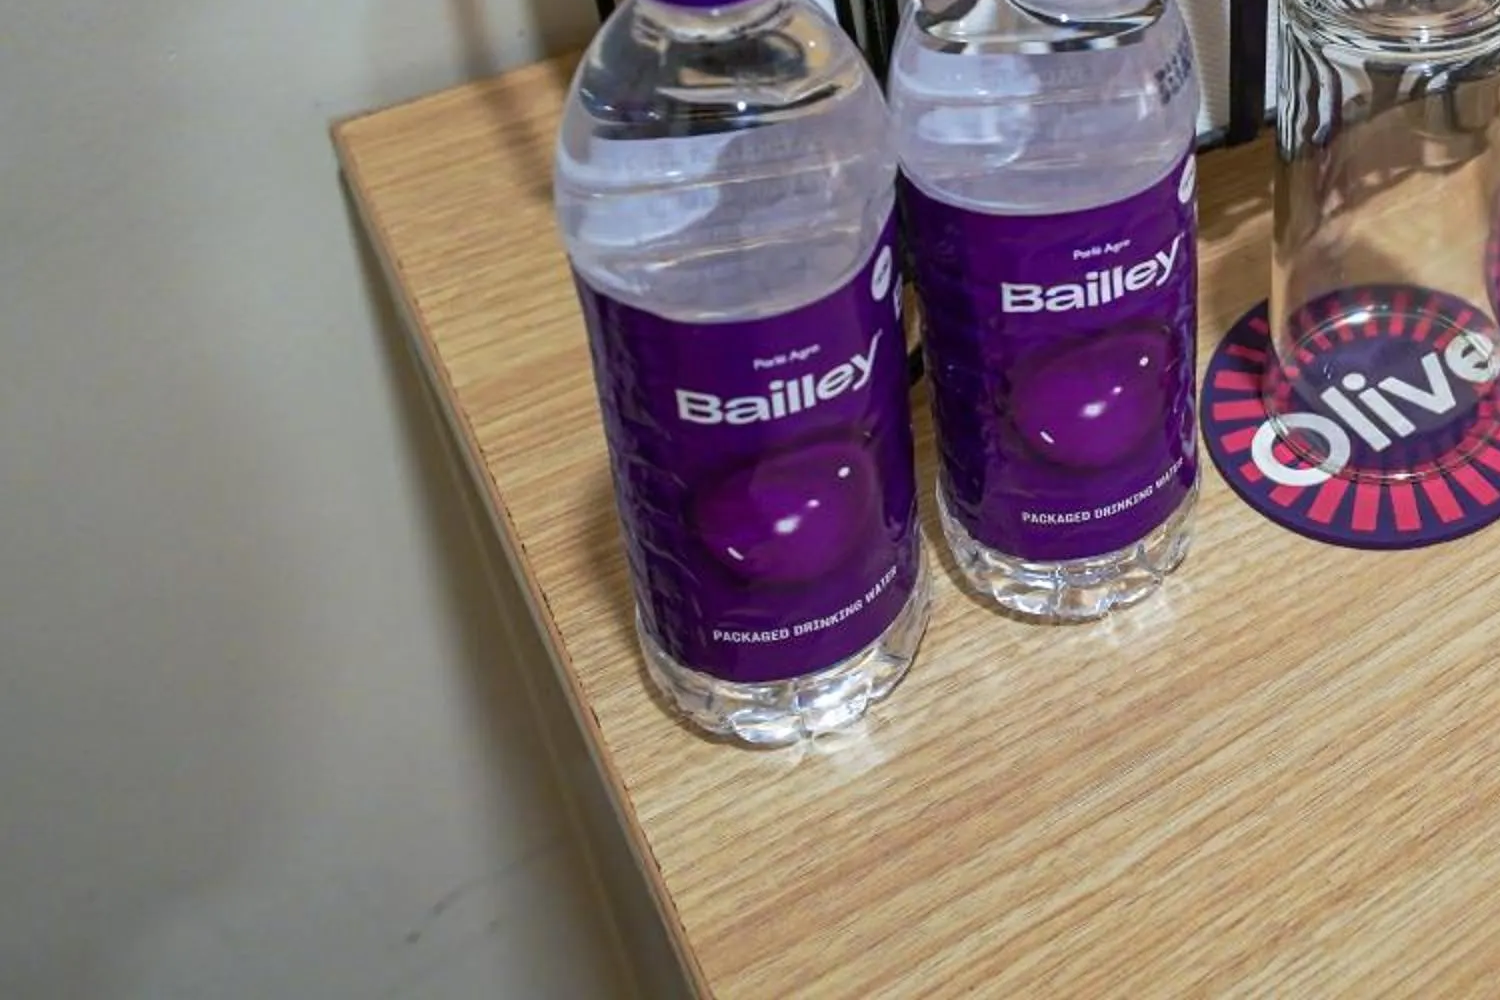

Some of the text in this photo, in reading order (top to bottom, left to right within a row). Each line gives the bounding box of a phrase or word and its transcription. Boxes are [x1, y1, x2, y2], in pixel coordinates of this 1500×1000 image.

[1001, 234, 1181, 314] Bailley
[674, 330, 881, 425] Bailley
[1021, 456, 1183, 525] PACKAGED DRINKING WATER
[713, 565, 897, 643] PACKAGED DRINKING WATER
